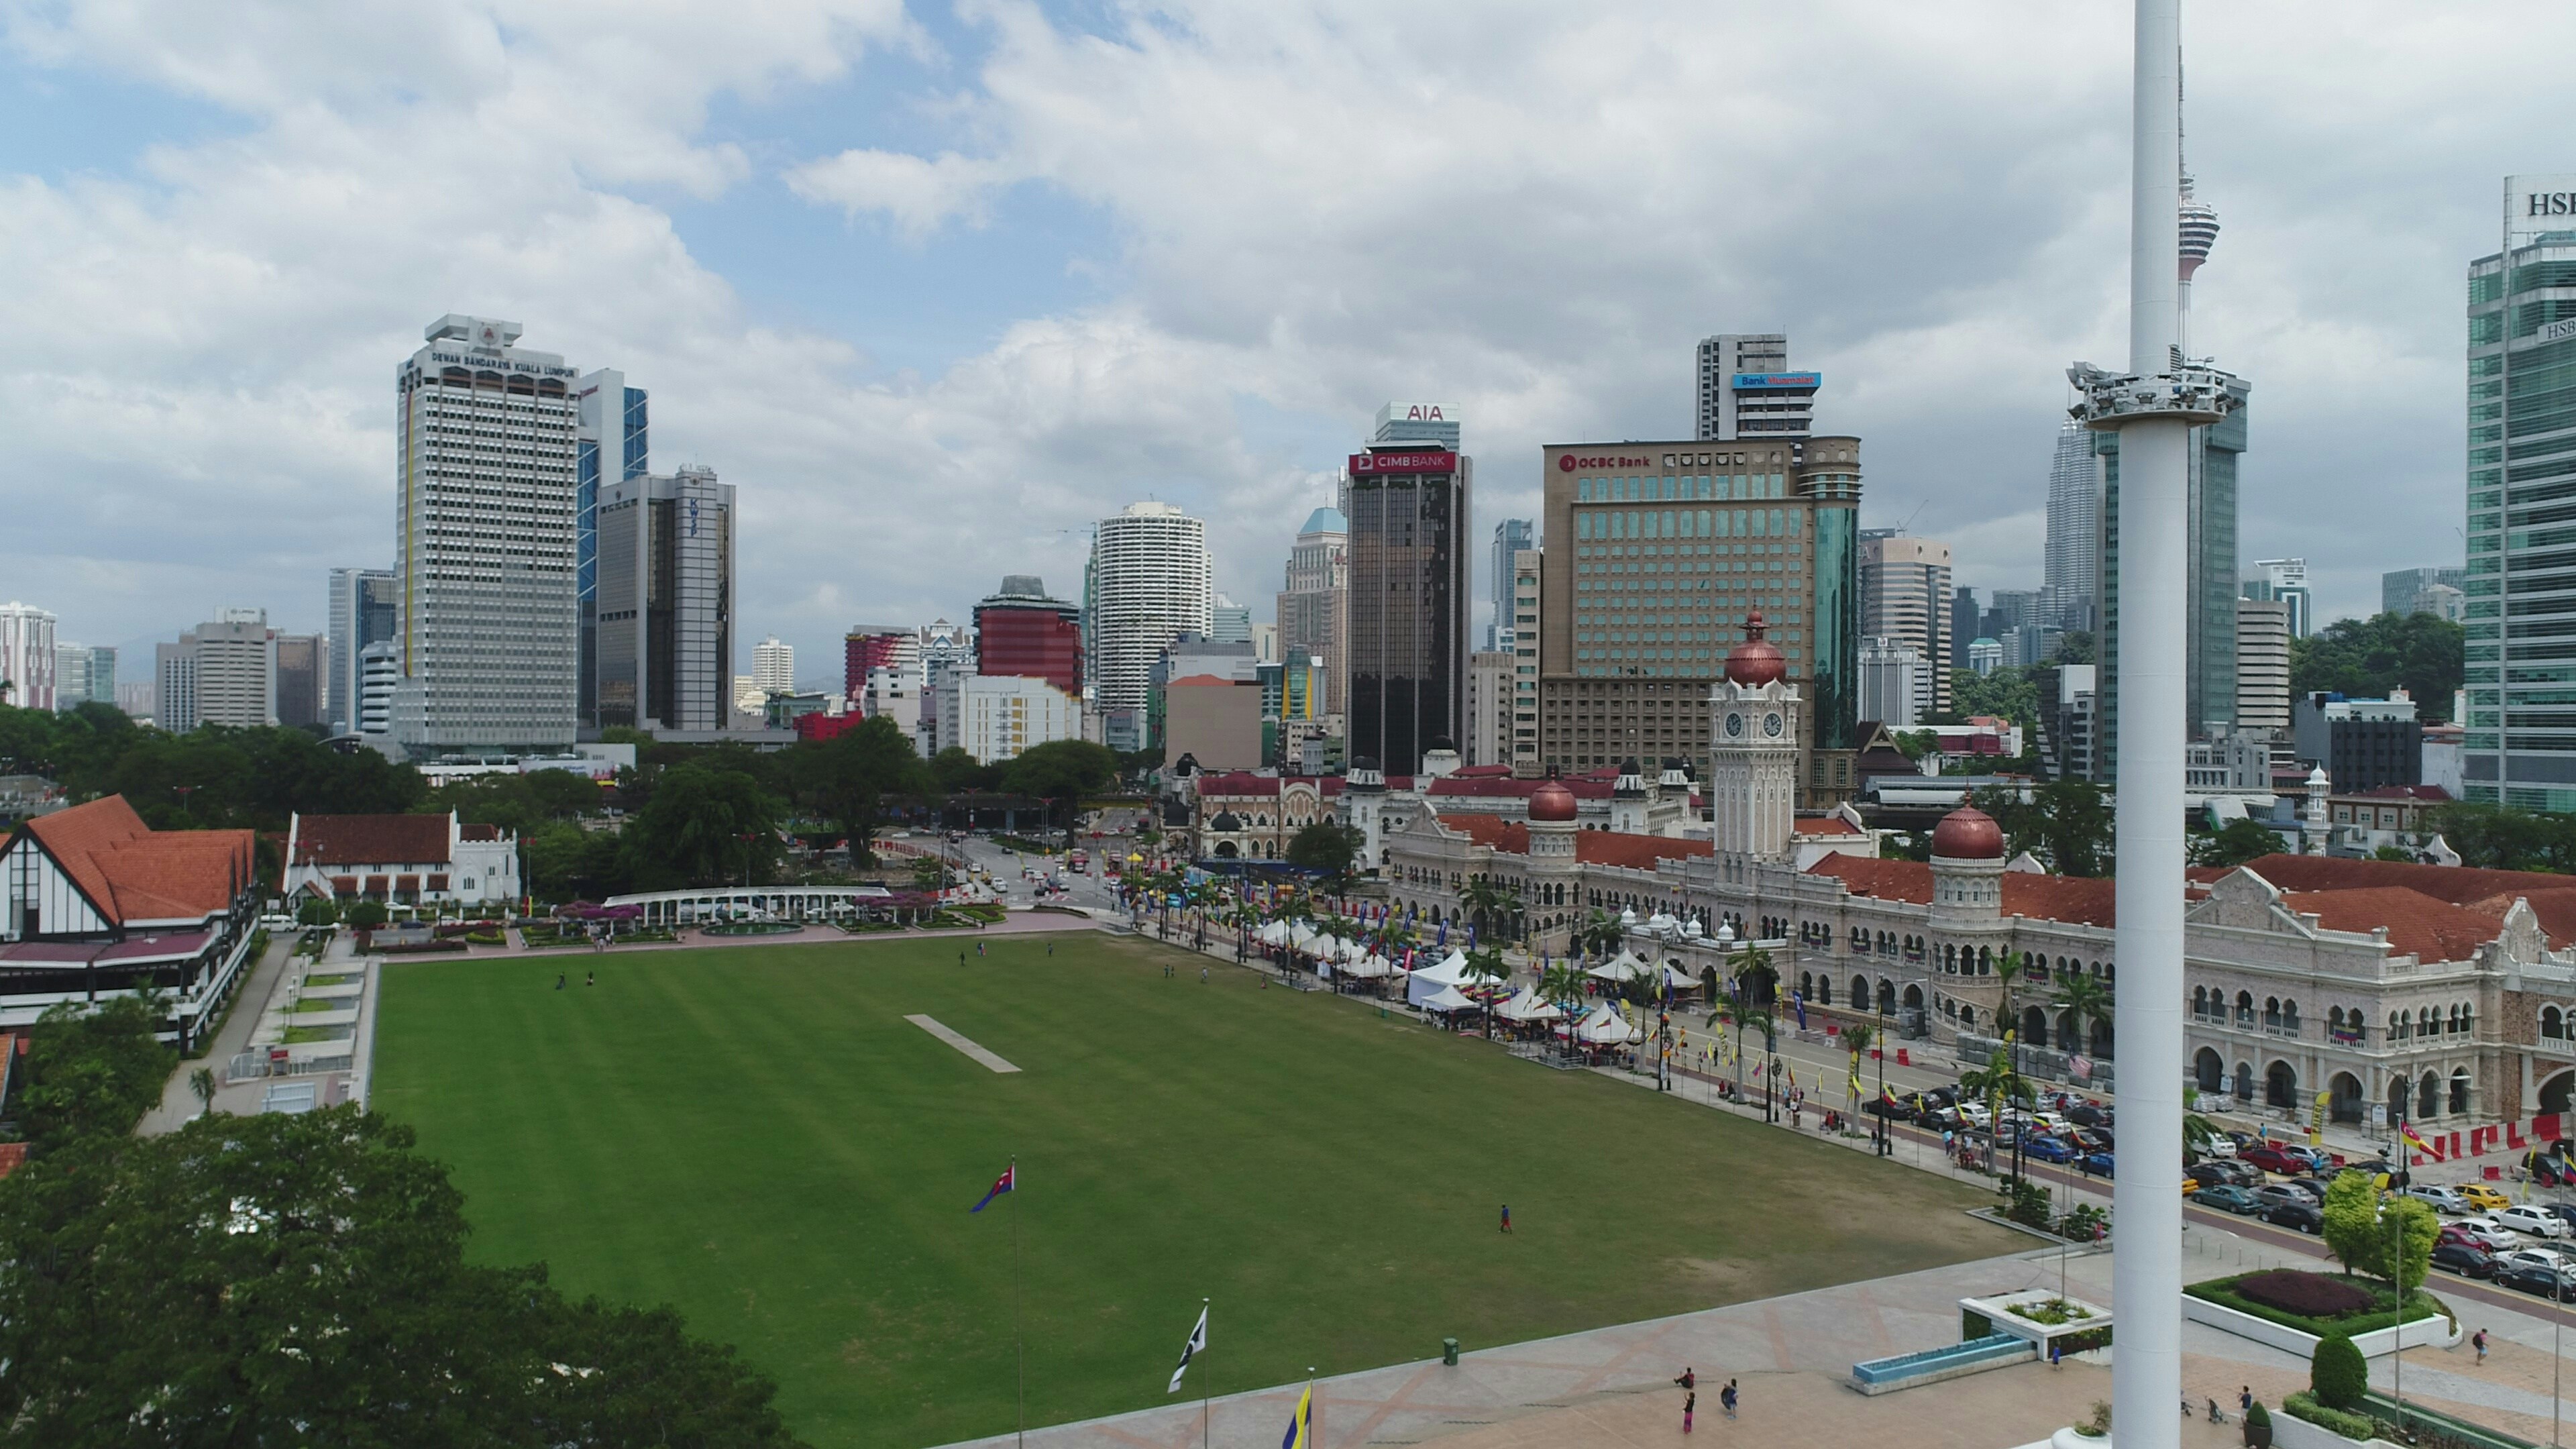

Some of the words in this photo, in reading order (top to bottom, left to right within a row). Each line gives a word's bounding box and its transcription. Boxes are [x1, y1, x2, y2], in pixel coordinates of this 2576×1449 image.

[432, 352, 461, 364] DEWAN
[464, 356, 511, 370] BANDARAYA
[515, 364, 541, 374] KUALA
[544, 366, 574, 378] LUMPUR
[1742, 376, 1766, 385] Bank
[1407, 405, 1444, 421] AIA
[1378, 457, 1410, 467] CIMB
[1412, 456, 1445, 466] BANK
[1578, 457, 1615, 468] OCBC
[1619, 456, 1650, 467] Bank
[690, 498, 698, 537] KWSP
